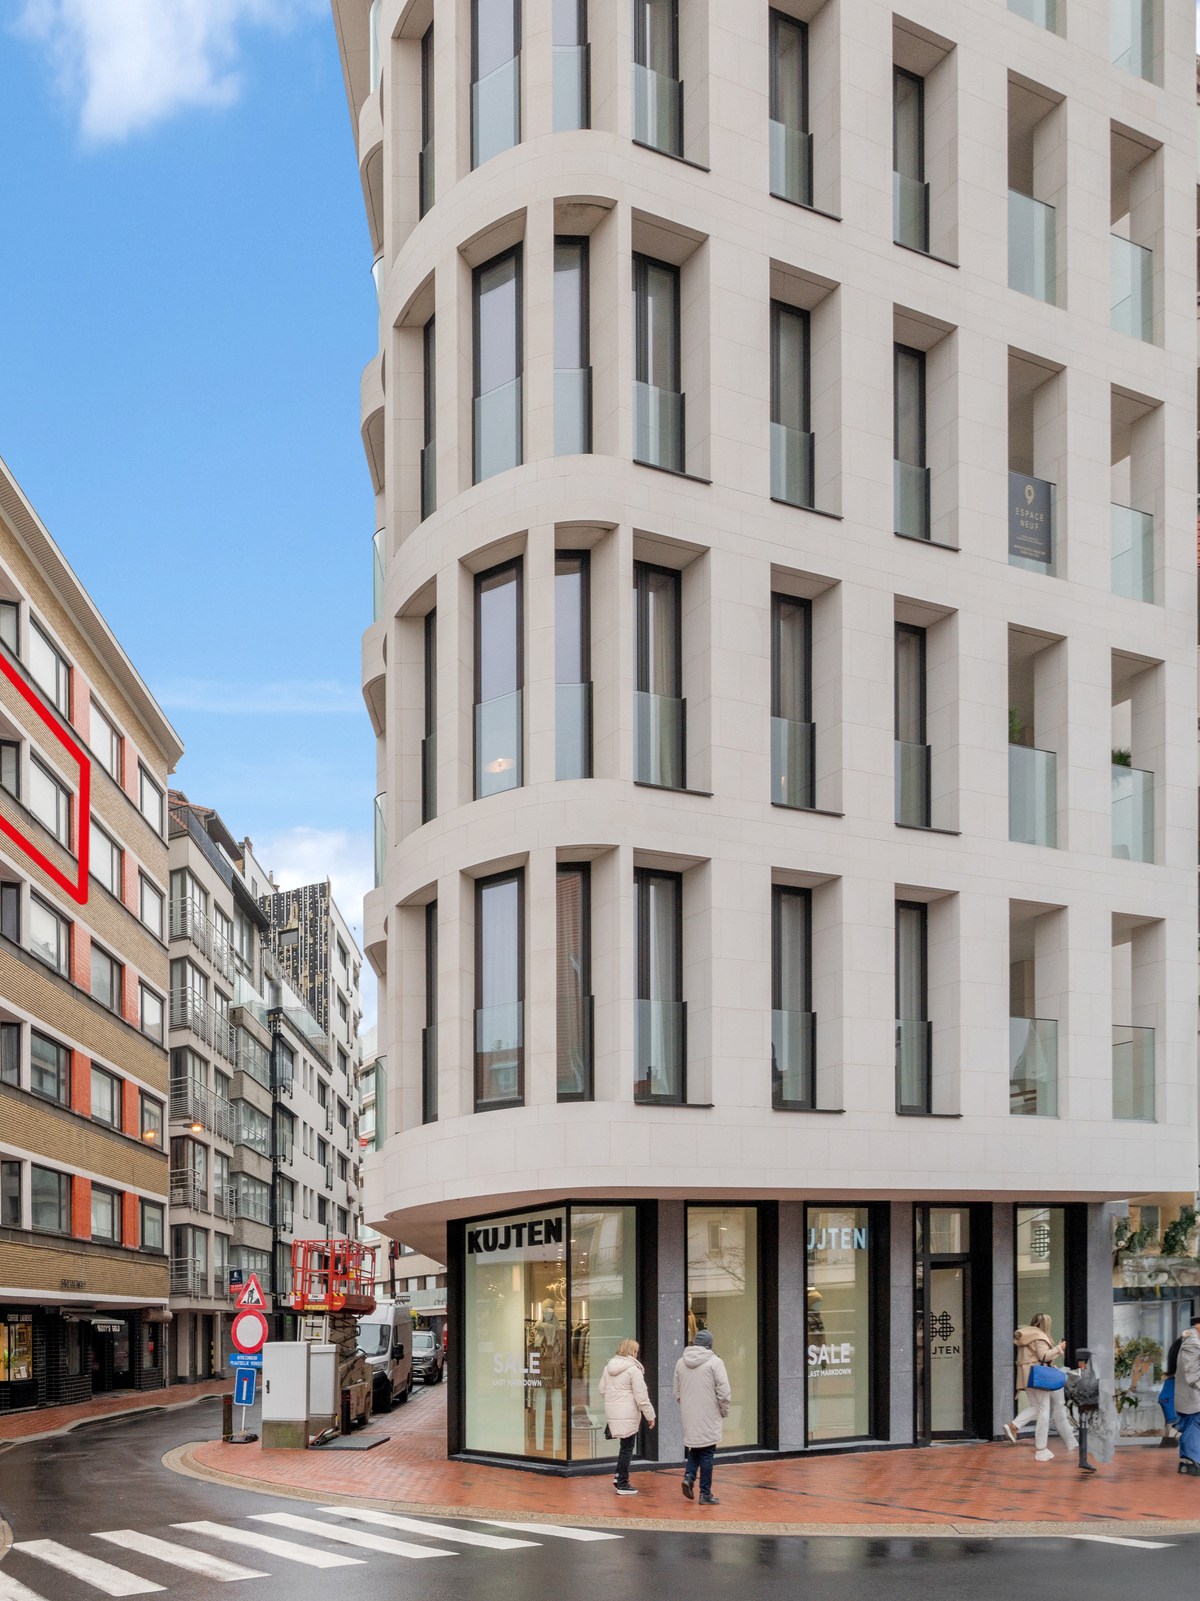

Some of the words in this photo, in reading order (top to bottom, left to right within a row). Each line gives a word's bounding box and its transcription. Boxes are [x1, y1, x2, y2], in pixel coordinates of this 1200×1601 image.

[1015, 507, 1045, 522] ESPACE
[468, 1217, 562, 1254] KUJTEN
[808, 1343, 851, 1366] SALE
[932, 1346, 960, 1355] JTEN
[494, 1352, 541, 1375] SALE
[821, 1368, 852, 1376] MARKDOWN
